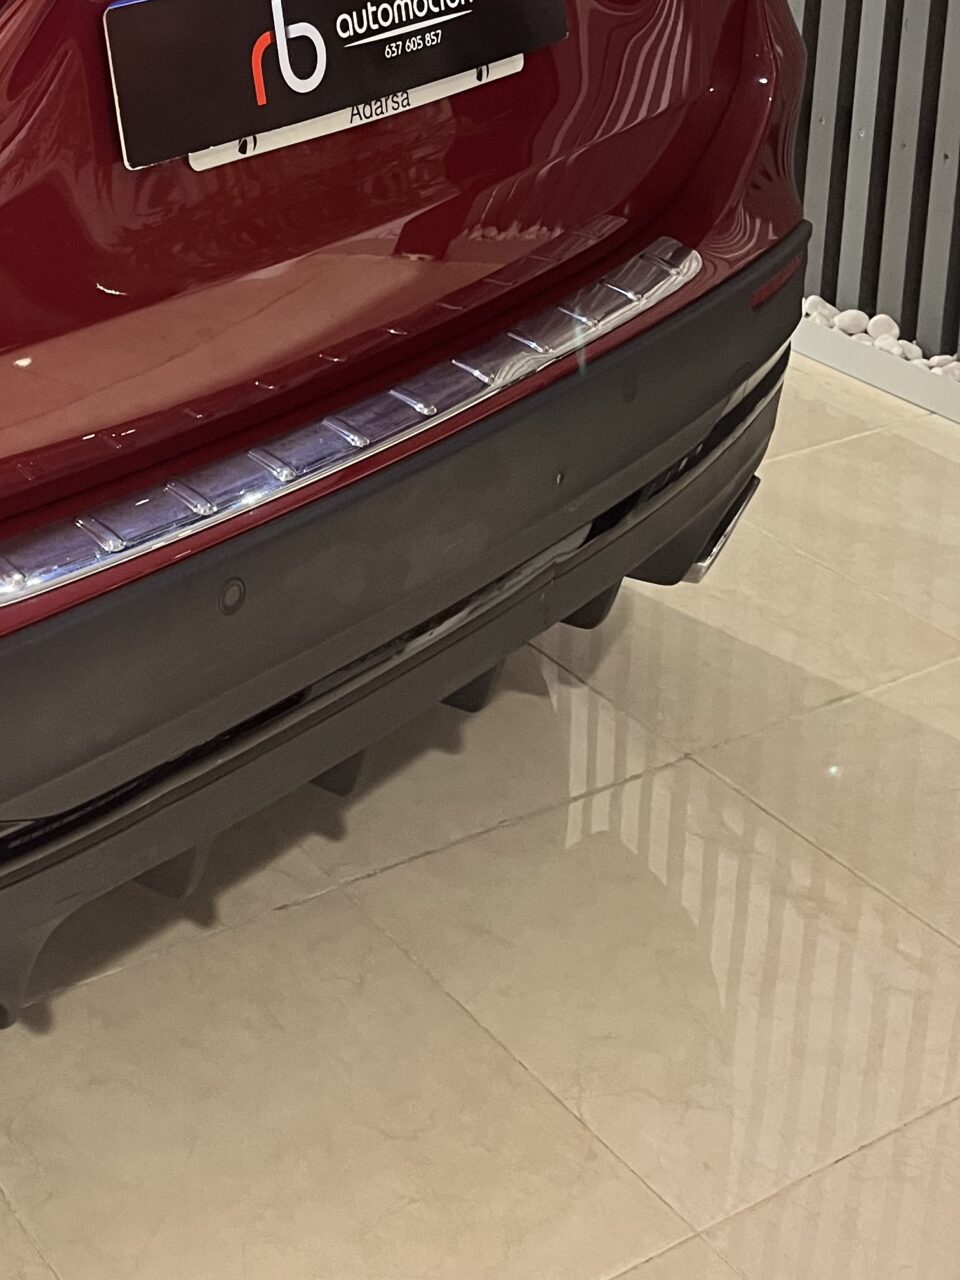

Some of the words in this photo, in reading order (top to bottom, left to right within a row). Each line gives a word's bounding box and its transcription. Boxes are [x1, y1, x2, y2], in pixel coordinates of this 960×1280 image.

[384, 41, 403, 59] 637
[405, 35, 424, 53] 605
[424, 29, 442, 47] 857
[349, 90, 411, 124] Adarsa
